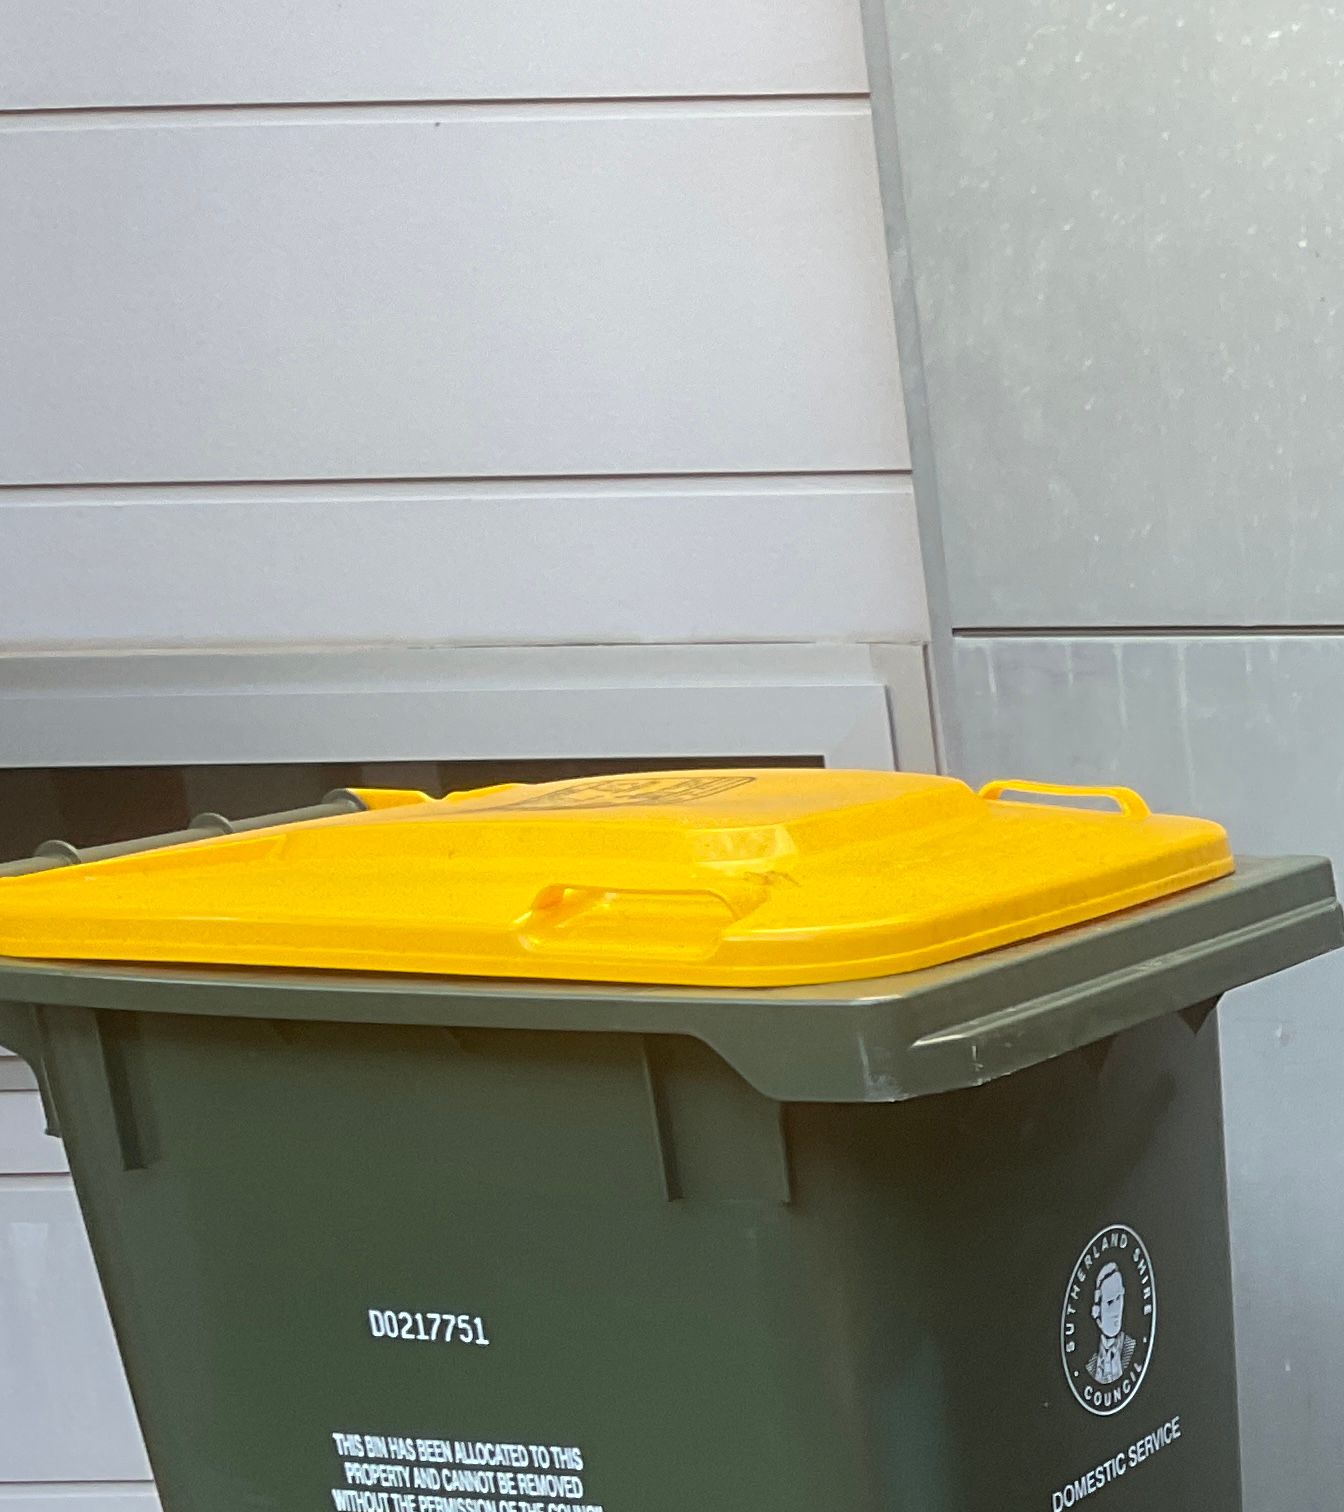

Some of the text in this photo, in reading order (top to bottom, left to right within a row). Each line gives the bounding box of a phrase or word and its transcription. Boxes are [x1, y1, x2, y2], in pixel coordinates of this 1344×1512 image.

[1065, 1232, 1153, 1353] SUTHERLAND SHIRE
[1083, 1361, 1143, 1407] COUNCIL
[332, 1432, 584, 1471] THIS BIN HAS BEEN ALLOCATED TO THIS
[1128, 1415, 1181, 1469] SERVICE
[344, 1461, 584, 1499] PROPERTY AND CANNOT BE REMOVED
